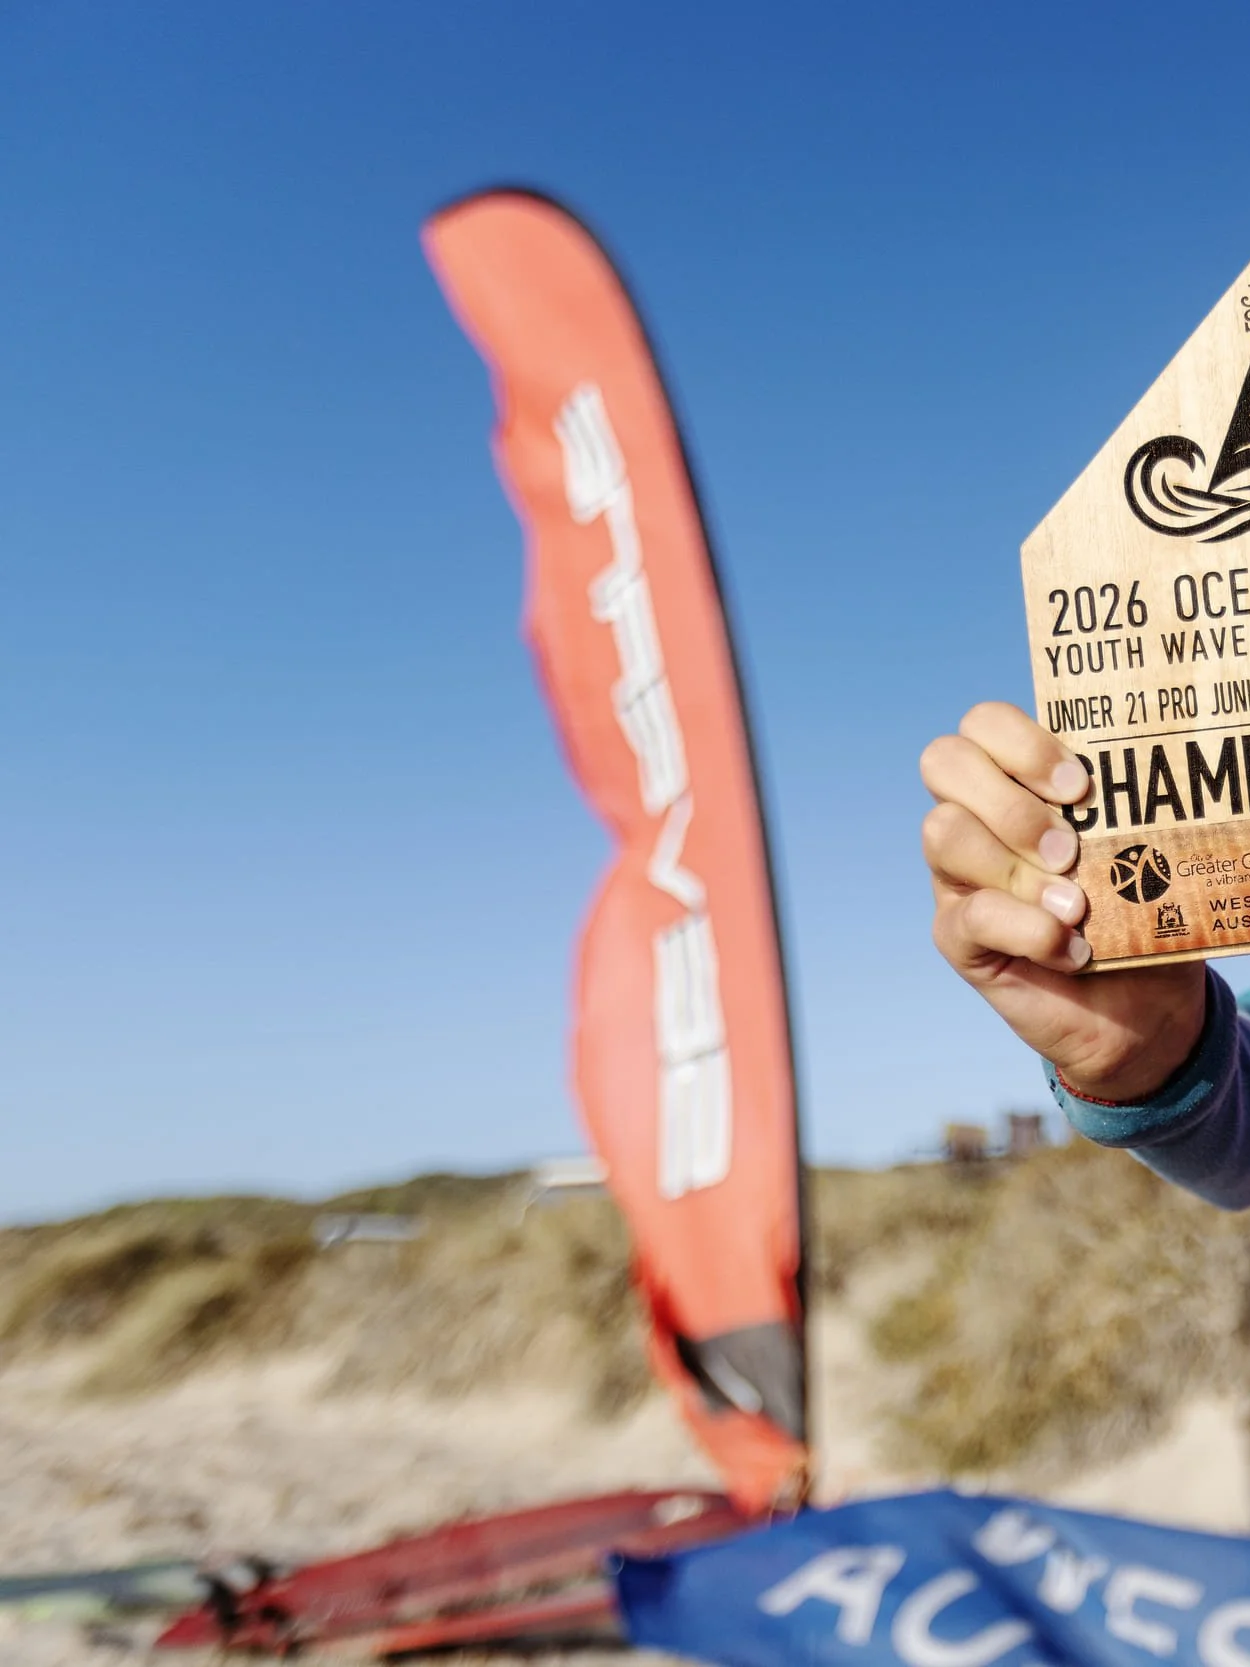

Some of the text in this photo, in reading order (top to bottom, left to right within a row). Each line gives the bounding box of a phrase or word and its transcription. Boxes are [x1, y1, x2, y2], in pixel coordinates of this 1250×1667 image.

[1049, 580, 1148, 637] 2026
[1045, 636, 1145, 678] YOUTH
[1161, 624, 1248, 665] WAVE
[1047, 695, 1114, 734] UNDER
[1126, 690, 1147, 723] 21
[1158, 685, 1200, 721] PRO
[1177, 858, 1237, 878] Greater
